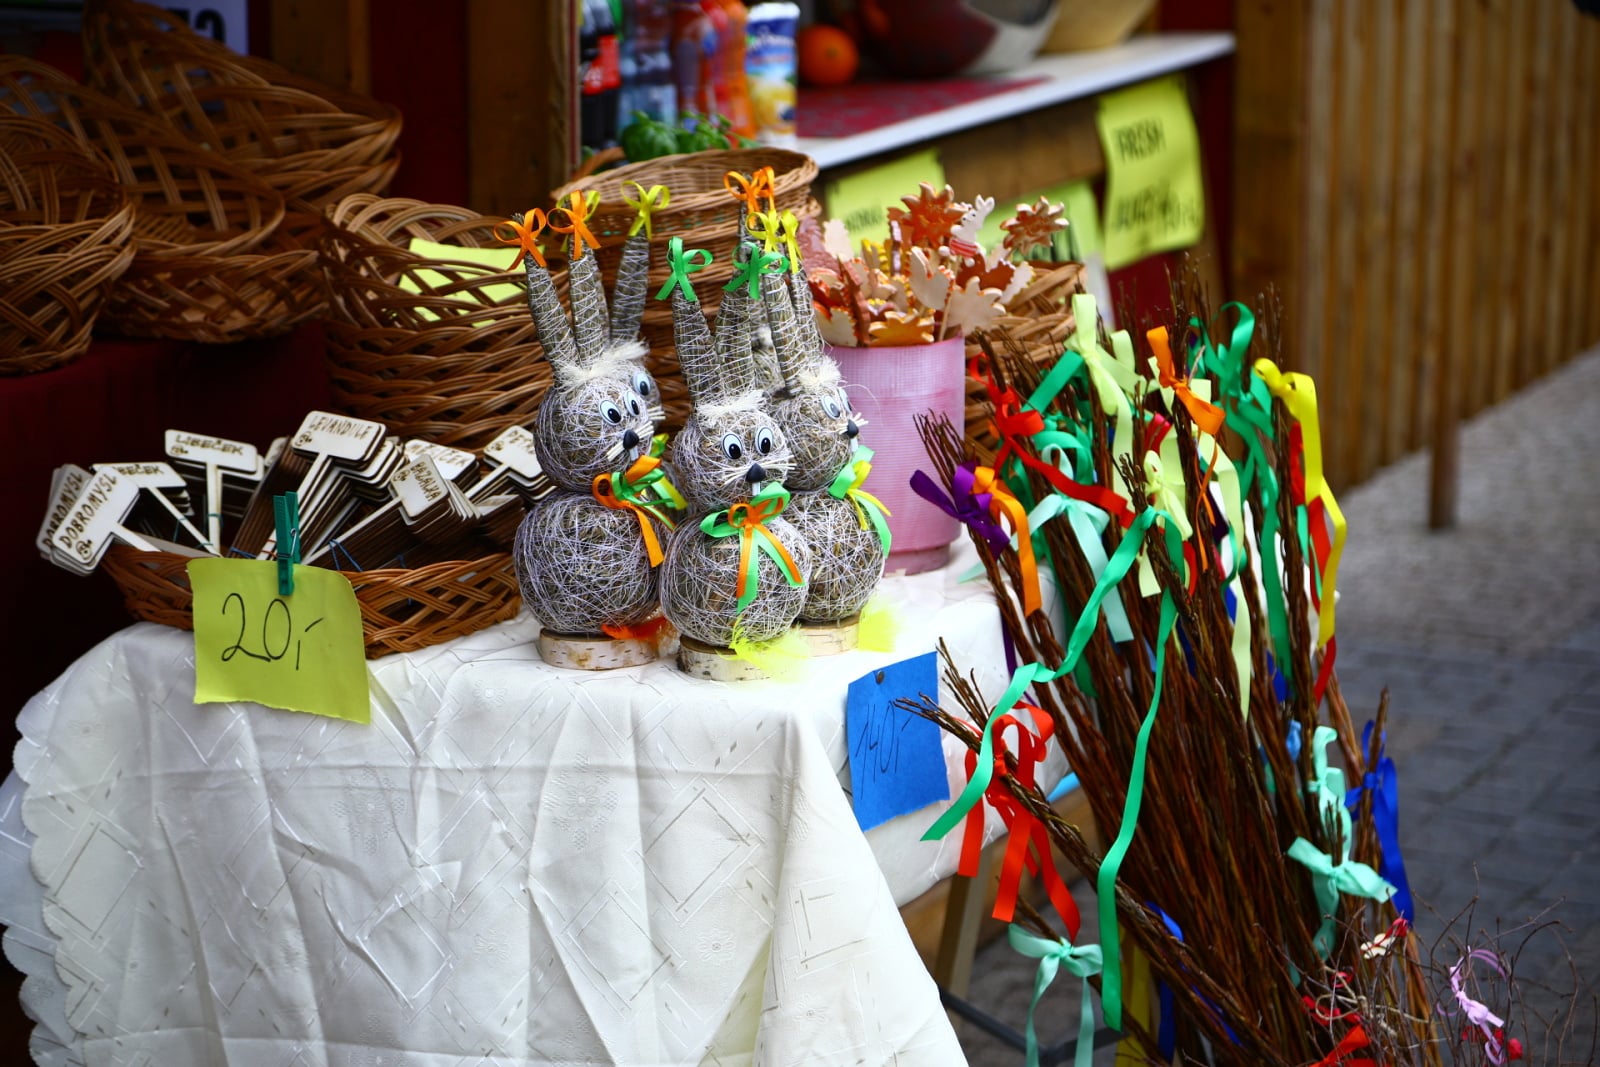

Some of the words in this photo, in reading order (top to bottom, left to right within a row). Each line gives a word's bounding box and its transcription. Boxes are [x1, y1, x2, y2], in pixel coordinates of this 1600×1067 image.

[309, 415, 373, 440] LEVANDULE
[112, 464, 164, 477] BEČEK
[410, 461, 443, 502] BAZALKA
[59, 473, 117, 549] DOBROMYSL
[221, 592, 324, 671] 20,-
